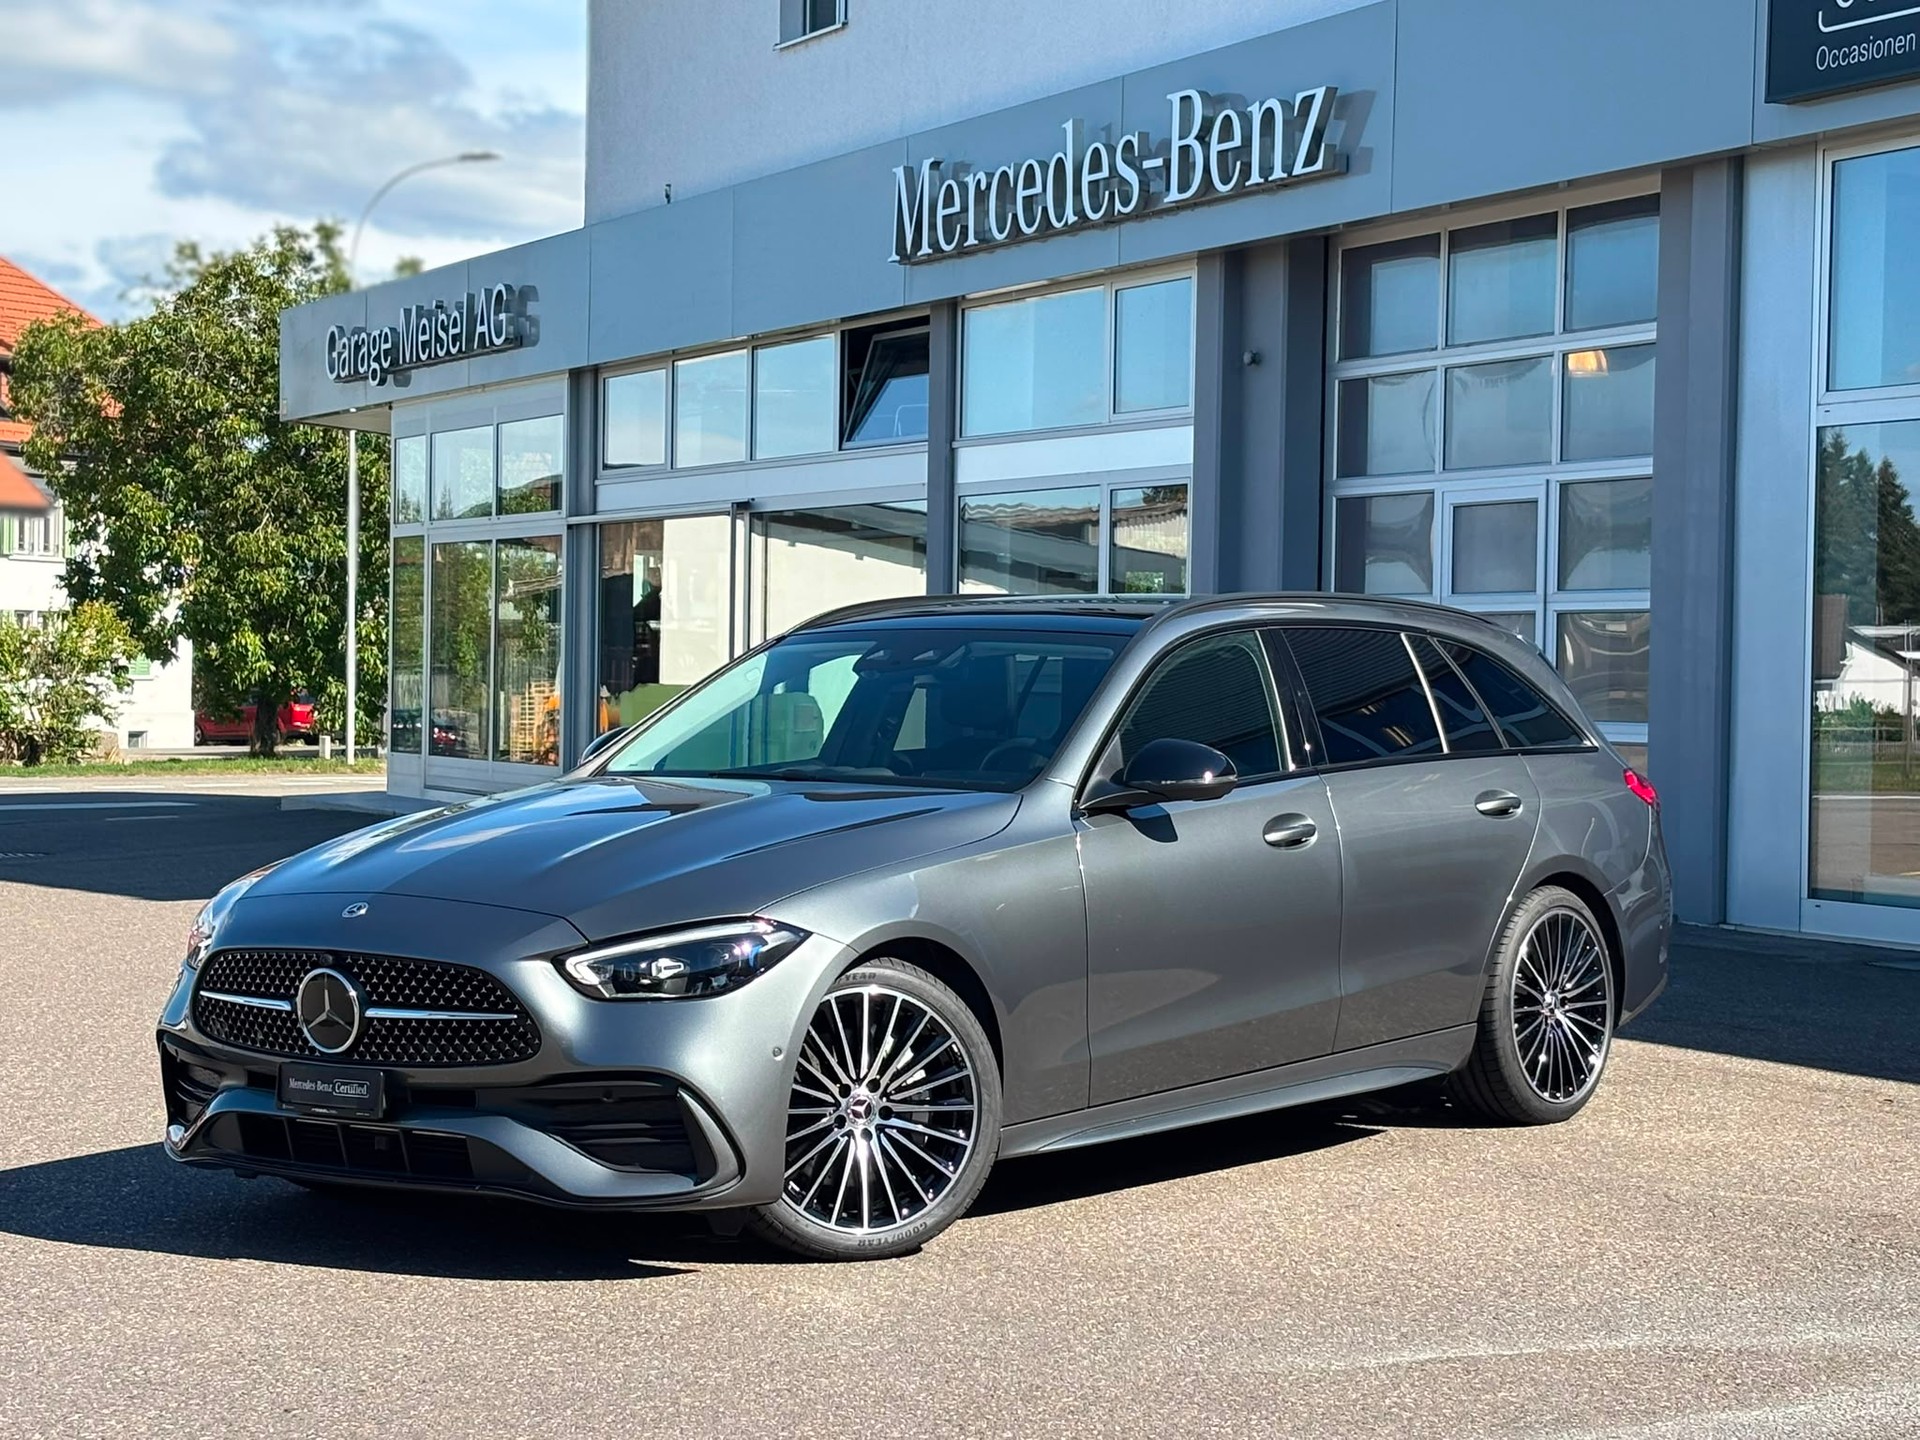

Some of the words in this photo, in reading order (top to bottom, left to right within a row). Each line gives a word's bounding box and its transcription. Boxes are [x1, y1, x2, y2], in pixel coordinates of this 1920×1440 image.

[1816, 33, 1916, 70] Occasionen
[887, 86, 1333, 263] Mercedes-Benz
[325, 325, 392, 387] Garage
[399, 292, 470, 365] Meisel
[474, 283, 507, 349] AG
